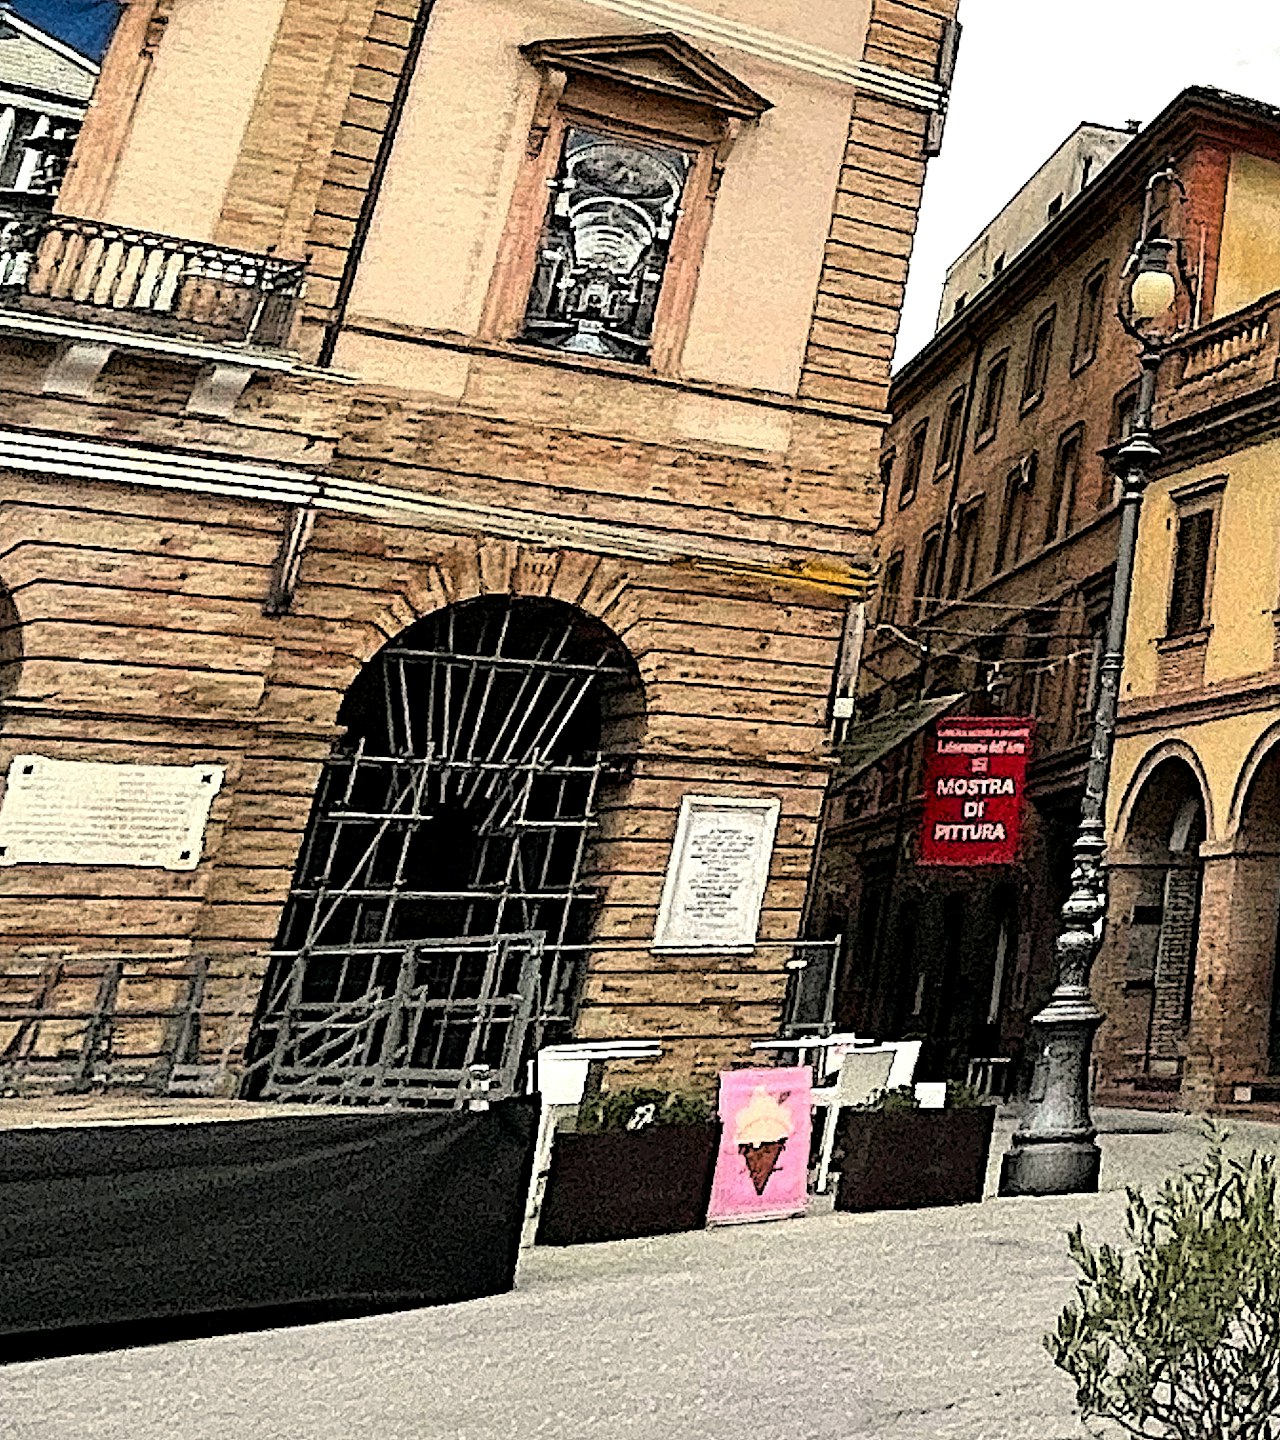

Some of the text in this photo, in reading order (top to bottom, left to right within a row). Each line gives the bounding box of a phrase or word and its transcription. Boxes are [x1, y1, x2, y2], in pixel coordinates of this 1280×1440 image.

[937, 778, 1015, 796] MOSTRA
[963, 801, 985, 818] DI
[933, 822, 1006, 841] PITTURA
